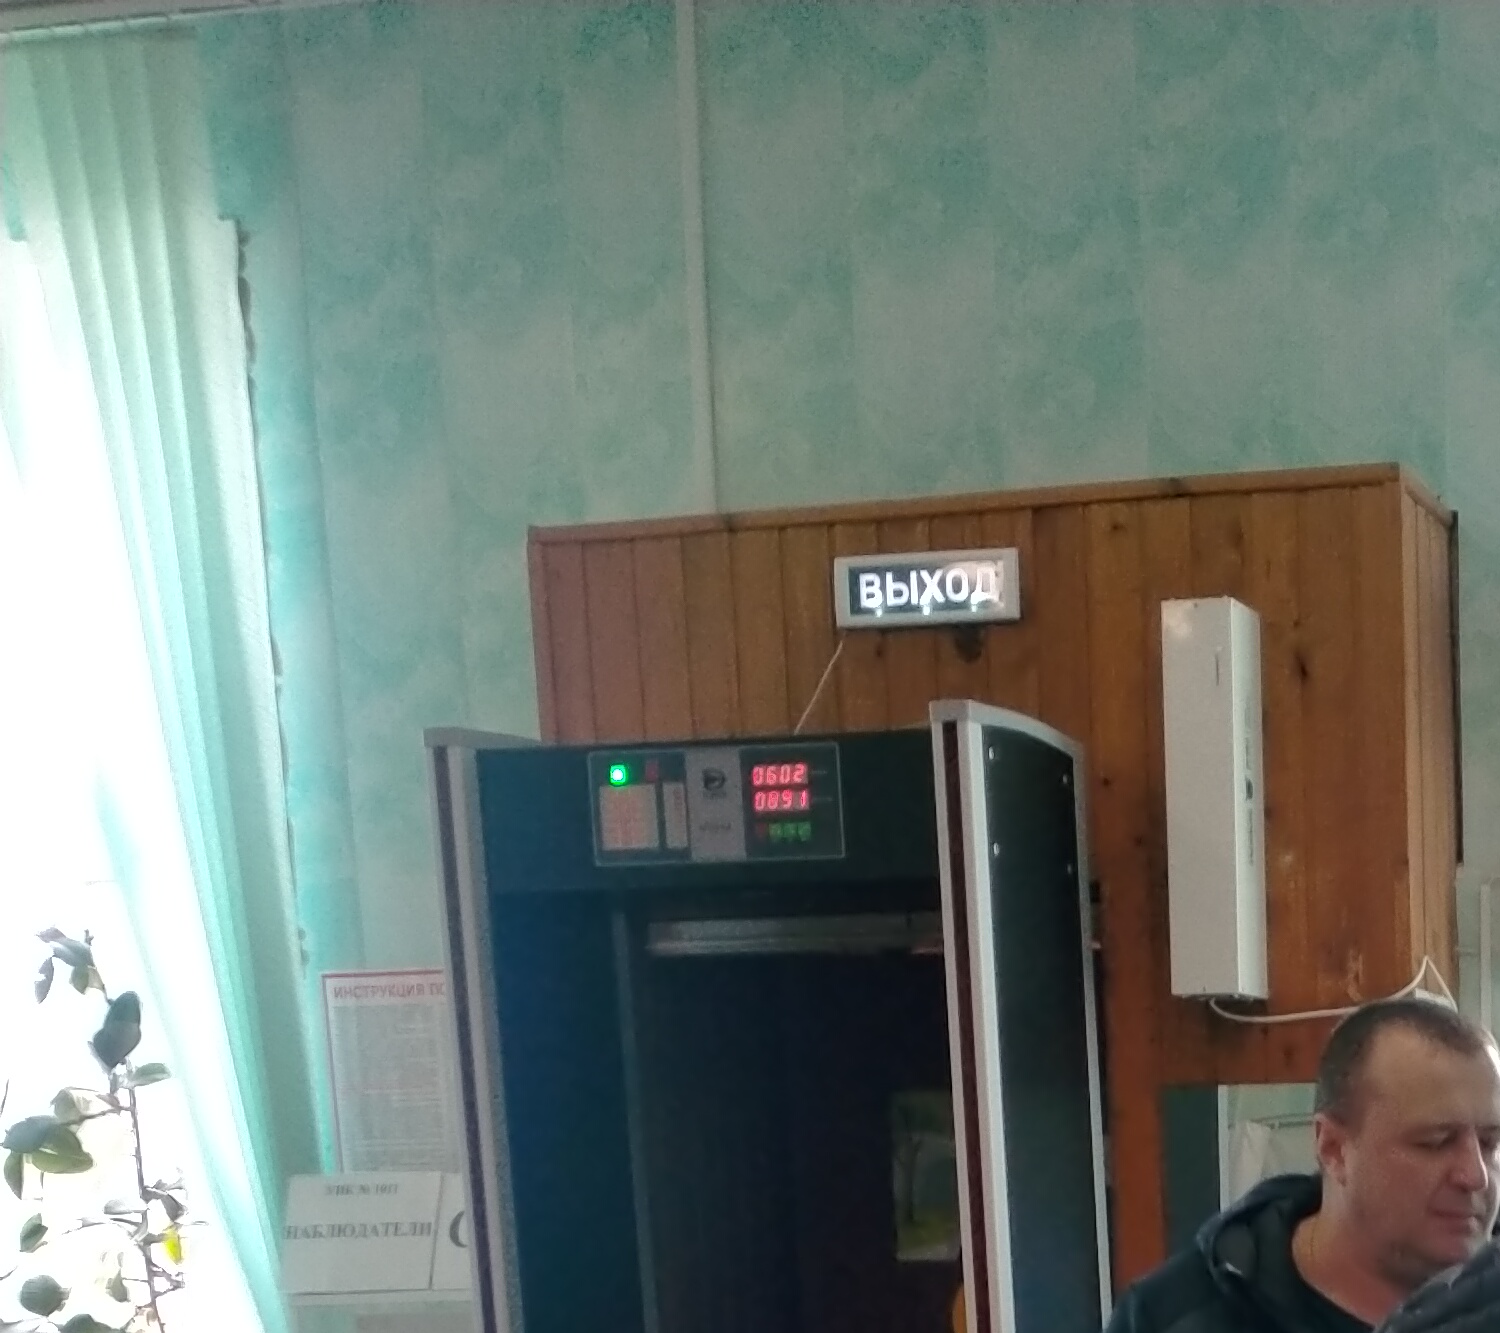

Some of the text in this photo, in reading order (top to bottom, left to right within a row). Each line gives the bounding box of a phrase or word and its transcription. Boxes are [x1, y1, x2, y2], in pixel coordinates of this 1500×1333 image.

[858, 566, 1001, 609] ВЫХОД
[752, 762, 807, 786] 0602
[333, 983, 425, 998] ИНСТРУКЦИЯ
[284, 1221, 433, 1240] НАБЛЮДАТЕЛИ
